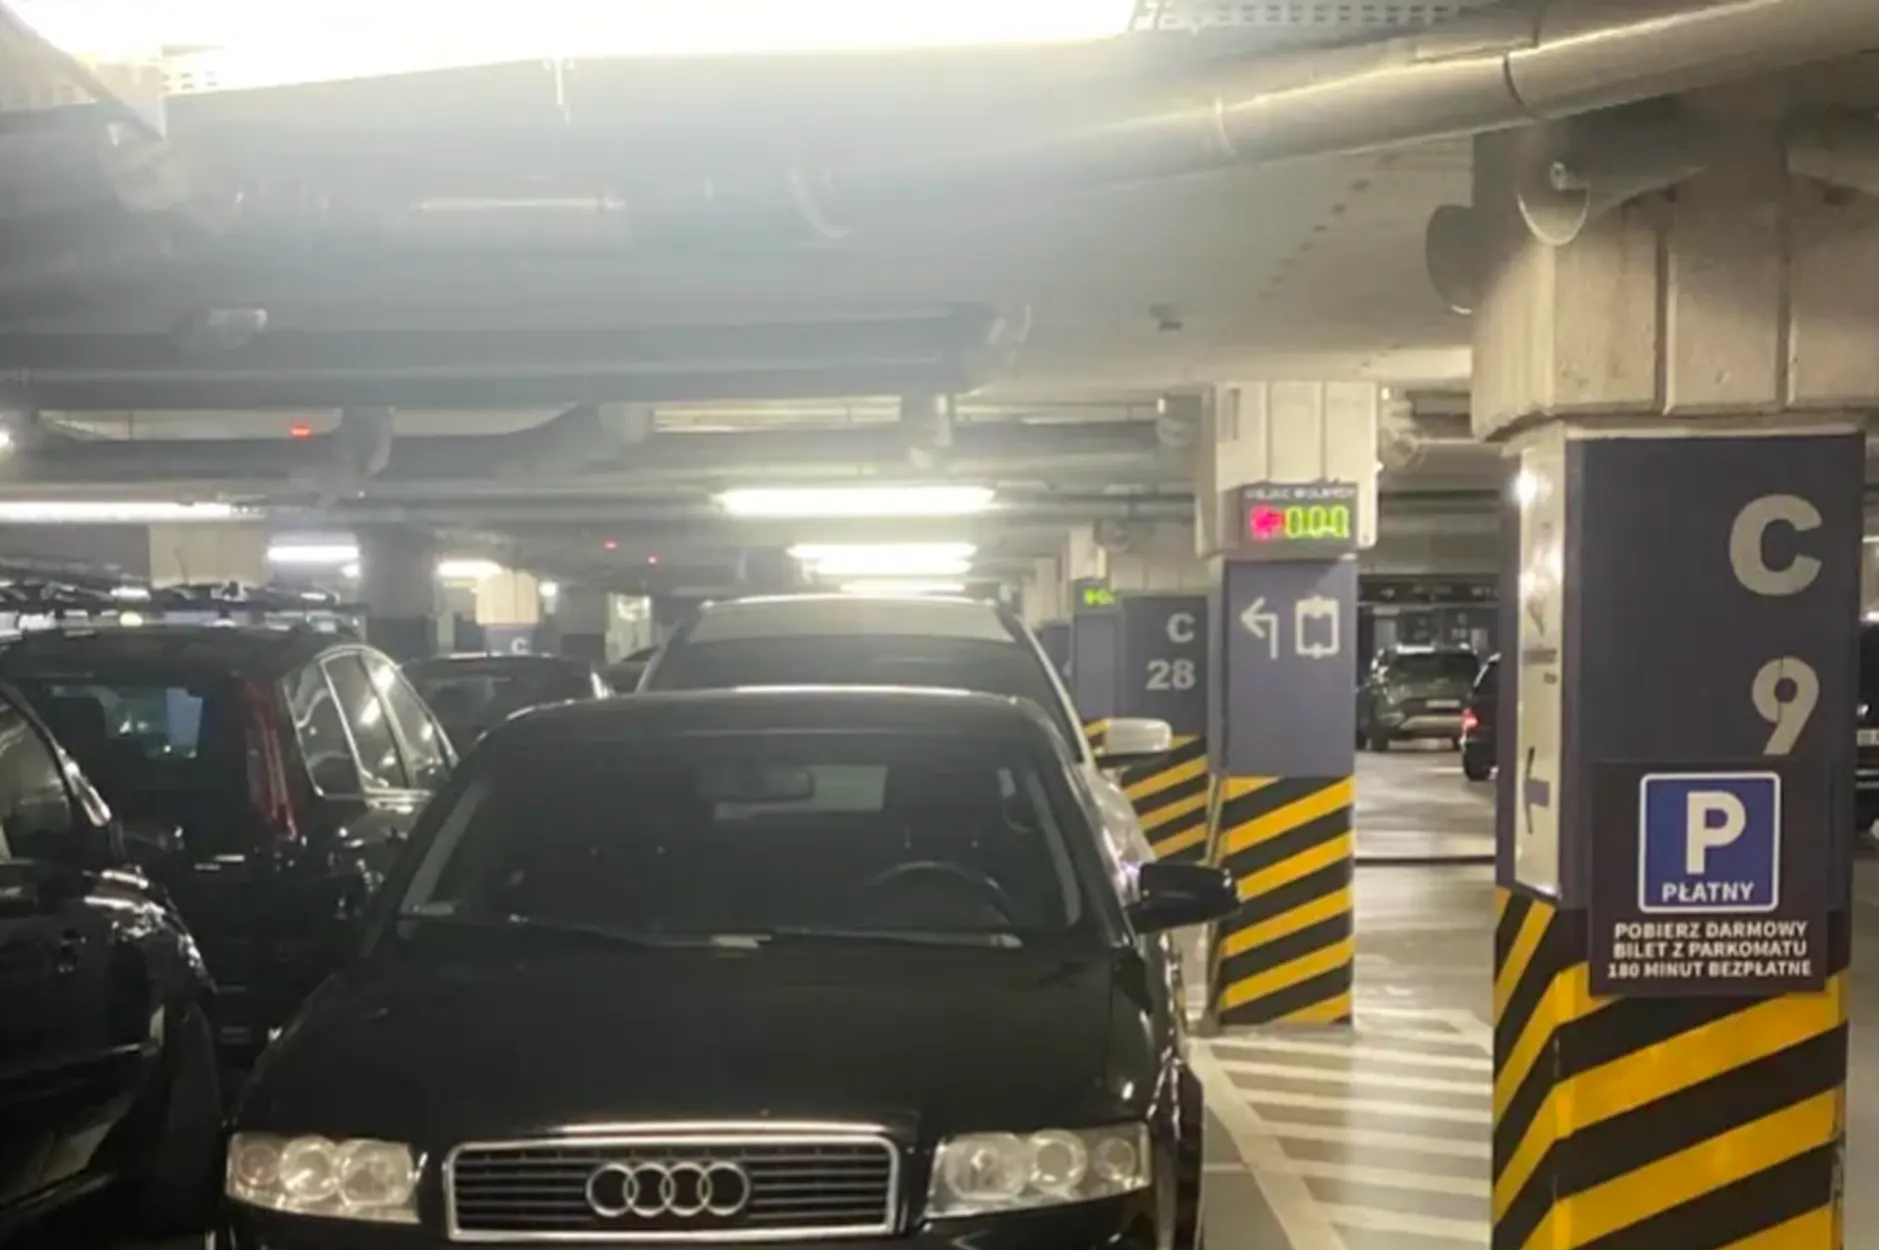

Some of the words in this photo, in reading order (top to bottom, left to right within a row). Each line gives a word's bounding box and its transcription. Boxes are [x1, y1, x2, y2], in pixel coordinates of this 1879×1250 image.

[1729, 493, 1822, 596] C
[1166, 612, 1196, 643] C
[1145, 659, 1196, 690] 28
[1751, 656, 1820, 756] 9
[1686, 790, 1747, 875] P
[1661, 881, 1755, 903] PŁATNY
[1614, 922, 1702, 940] POBIERZ
[1705, 920, 1808, 938] DARMOWY
[1613, 941, 1668, 959] BILET
[1672, 941, 1685, 958] Z
[1688, 939, 1807, 958] PARKOMATU
[1607, 962, 1641, 979] 180
[1643, 960, 1705, 978] MINUT
[1708, 959, 1812, 977] BEZPŁATNE
